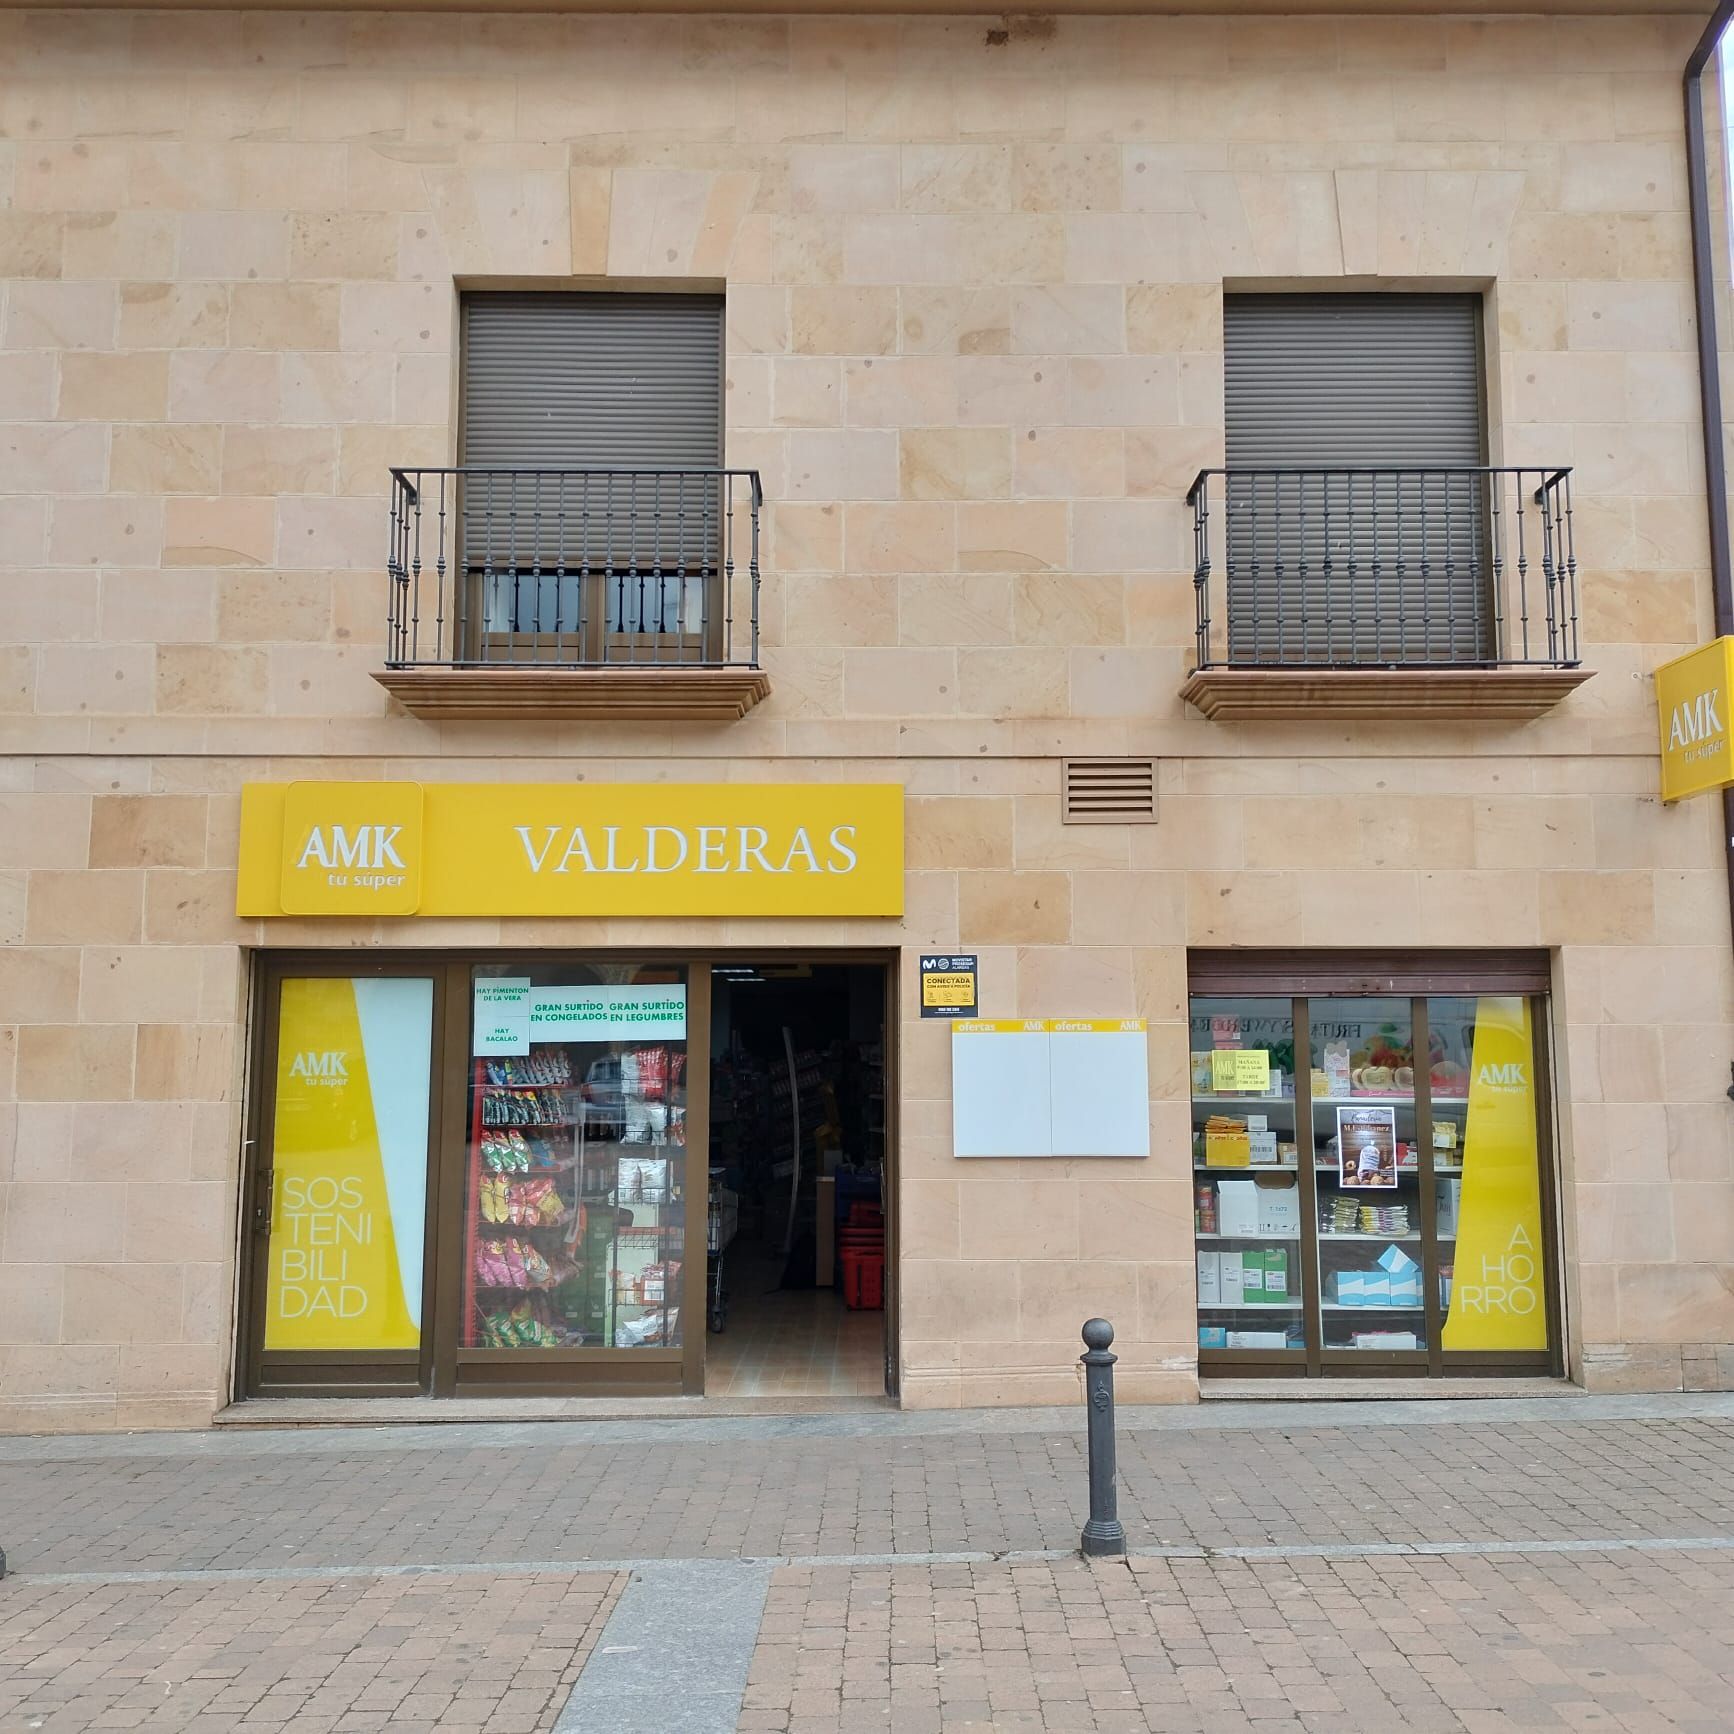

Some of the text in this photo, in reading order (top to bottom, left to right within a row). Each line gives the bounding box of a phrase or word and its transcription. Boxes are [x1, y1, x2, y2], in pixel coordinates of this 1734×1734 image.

[1668, 688, 1723, 752] AMK
[297, 825, 858, 874] AMK VALDERAS
[328, 871, 406, 891] tu súper
[530, 1012, 608, 1022] EN CONGELADOS
[534, 1003, 562, 1012] GRAN
[609, 1002, 639, 1011] GRAN
[610, 1012, 684, 1022] EN LEGUMBRES
[958, 1021, 1045, 1032] ofertas AMK
[1055, 1020, 1142, 1032] ofertas AMK
[288, 1051, 349, 1077] AMK
[1477, 1063, 1528, 1085] AMK
[305, 1078, 317, 1086] tu
[282, 1176, 364, 1210] SOS
[284, 1212, 373, 1245] TENI
[1507, 1223, 1534, 1251] A
[281, 1249, 347, 1282] BILI
[1481, 1253, 1535, 1283] HO
[279, 1285, 368, 1318] DAD
[1460, 1285, 1537, 1314] RRO
